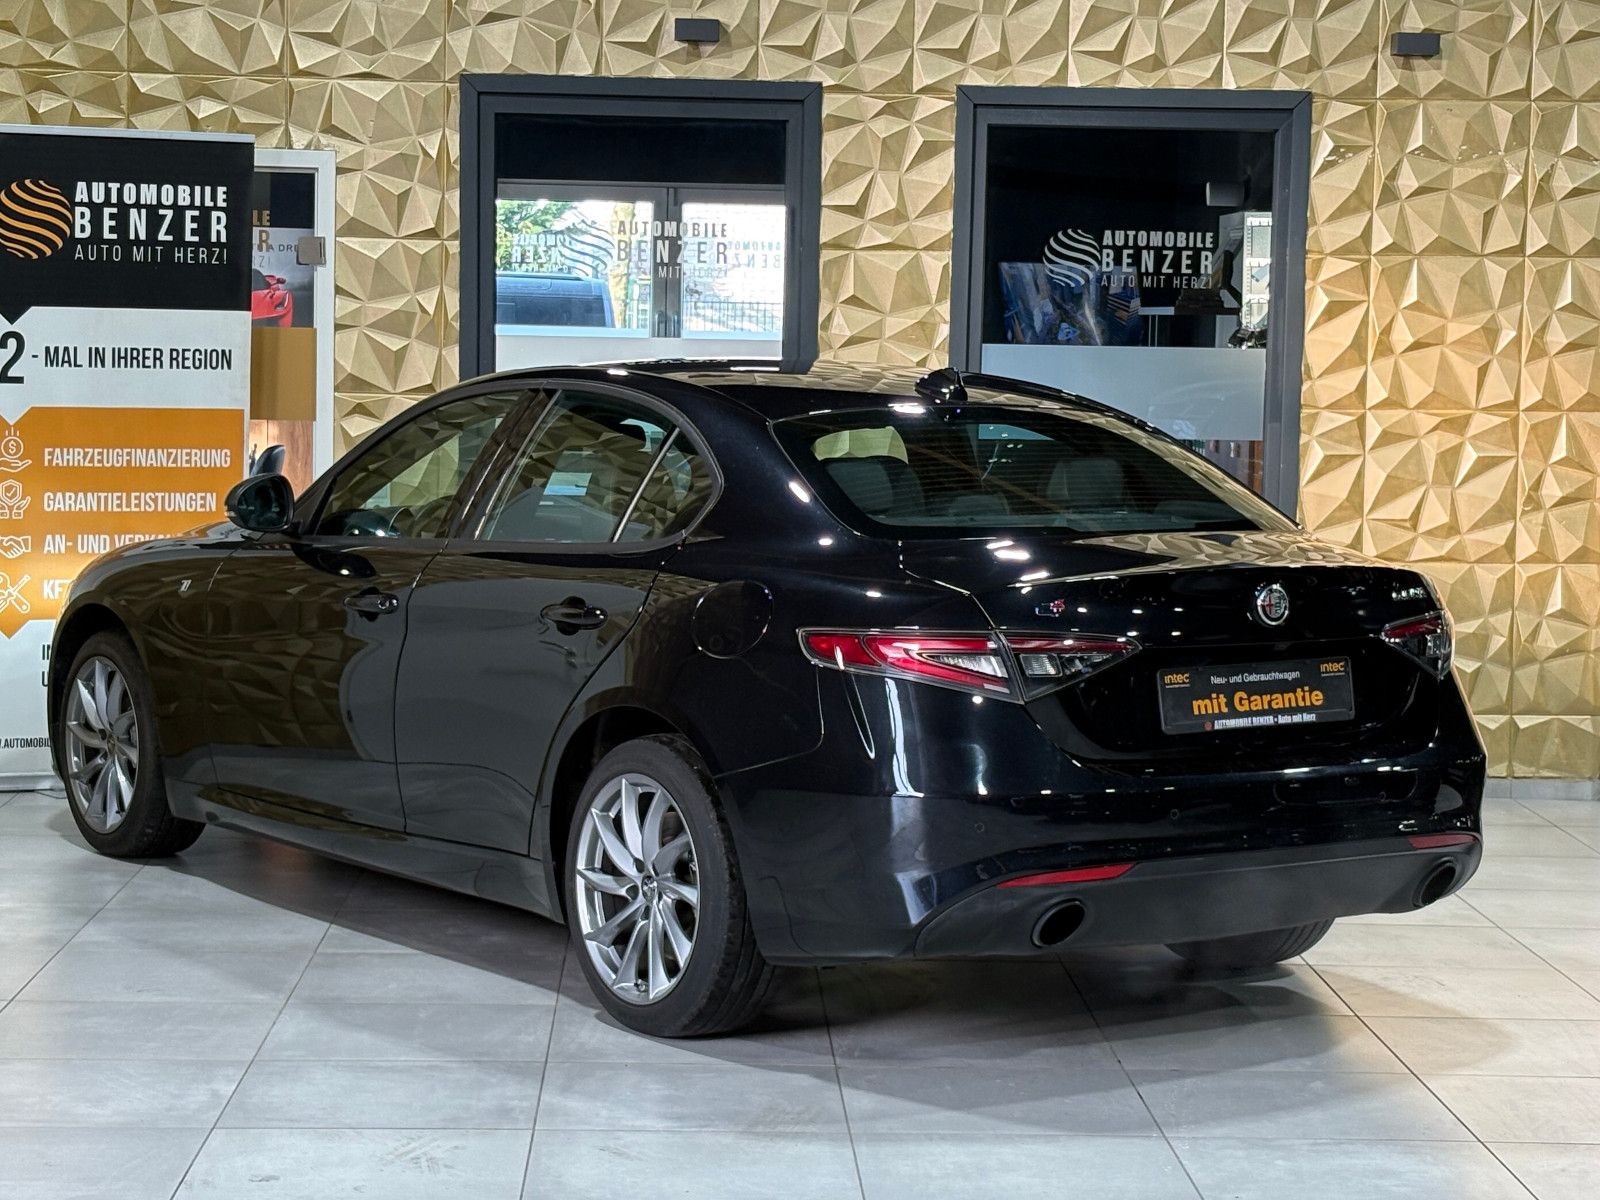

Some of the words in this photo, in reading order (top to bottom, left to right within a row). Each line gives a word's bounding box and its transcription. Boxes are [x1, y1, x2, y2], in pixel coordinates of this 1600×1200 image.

[75, 181, 227, 207] AUTOMOBILE
[74, 207, 227, 243] BENZER
[618, 221, 727, 237] AUTOMOBILE
[1102, 230, 1214, 248] AUTOMOBILE
[74, 245, 121, 262] AUTO
[133, 246, 162, 263] MIT
[175, 247, 227, 264] HERZ!
[617, 239, 728, 264] BENZER
[658, 265, 681, 279] MIT
[1101, 249, 1213, 275] BENZER
[1101, 274, 1135, 288] AUTO
[1143, 275, 1165, 288] MIT
[1173, 276, 1213, 289] HERZ!
[44, 346, 83, 368] MAL
[88, 347, 106, 368] IN
[112, 347, 164, 370] IHRER
[169, 348, 232, 370] REGION
[44, 447, 231, 468] FAHRZEUGFINANZIERUNG
[43, 492, 217, 512] GARANTIELEISTUNGEN
[43, 534, 73, 554] AN-
[77, 534, 110, 554] UND
[1211, 675, 1228, 685] Neu-
[1229, 673, 1242, 683] und
[1243, 671, 1300, 683] Gebrauchtwagen
[1192, 693, 1228, 715] mit
[1233, 686, 1324, 712] Garantie
